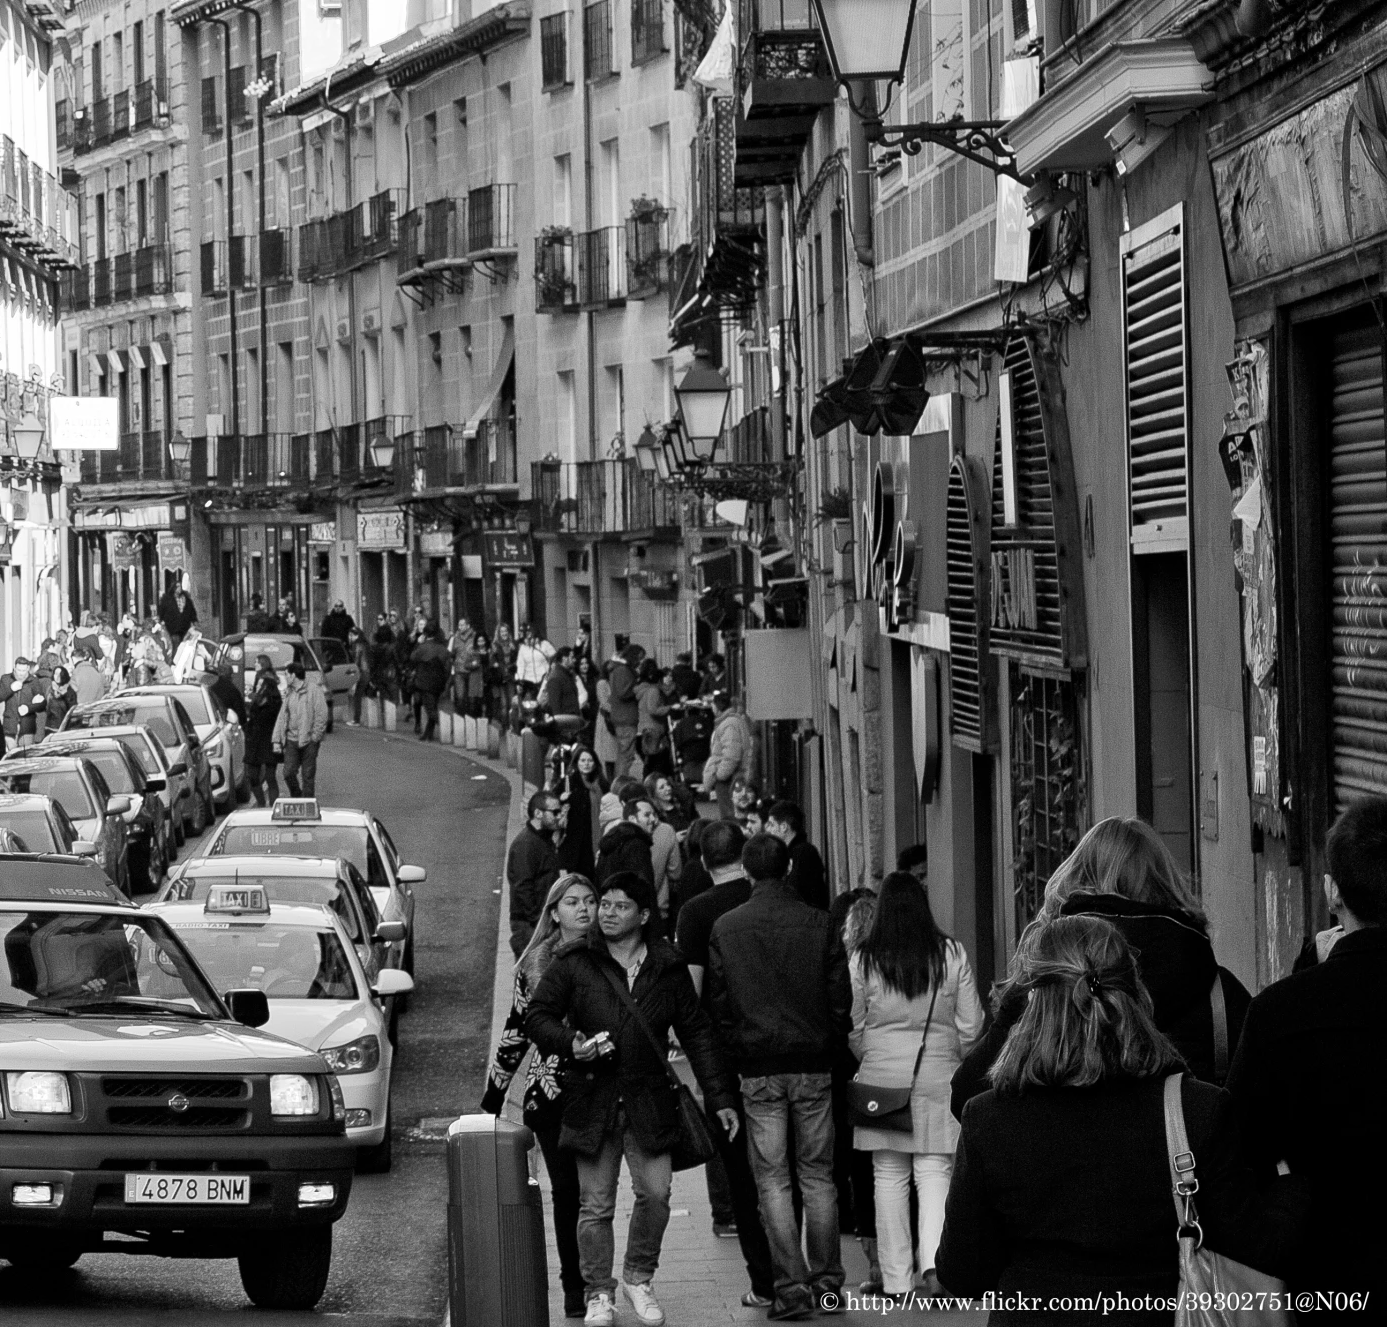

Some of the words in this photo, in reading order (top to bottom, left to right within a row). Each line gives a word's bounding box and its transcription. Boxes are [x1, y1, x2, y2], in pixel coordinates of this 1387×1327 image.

[284, 804, 304, 816] TAXI
[253, 831, 280, 845] LIBRE
[47, 887, 109, 898] NISSAN
[221, 892, 248, 906] TAXI
[141, 1178, 198, 1200] 4878
[207, 1179, 245, 1200] BNM
